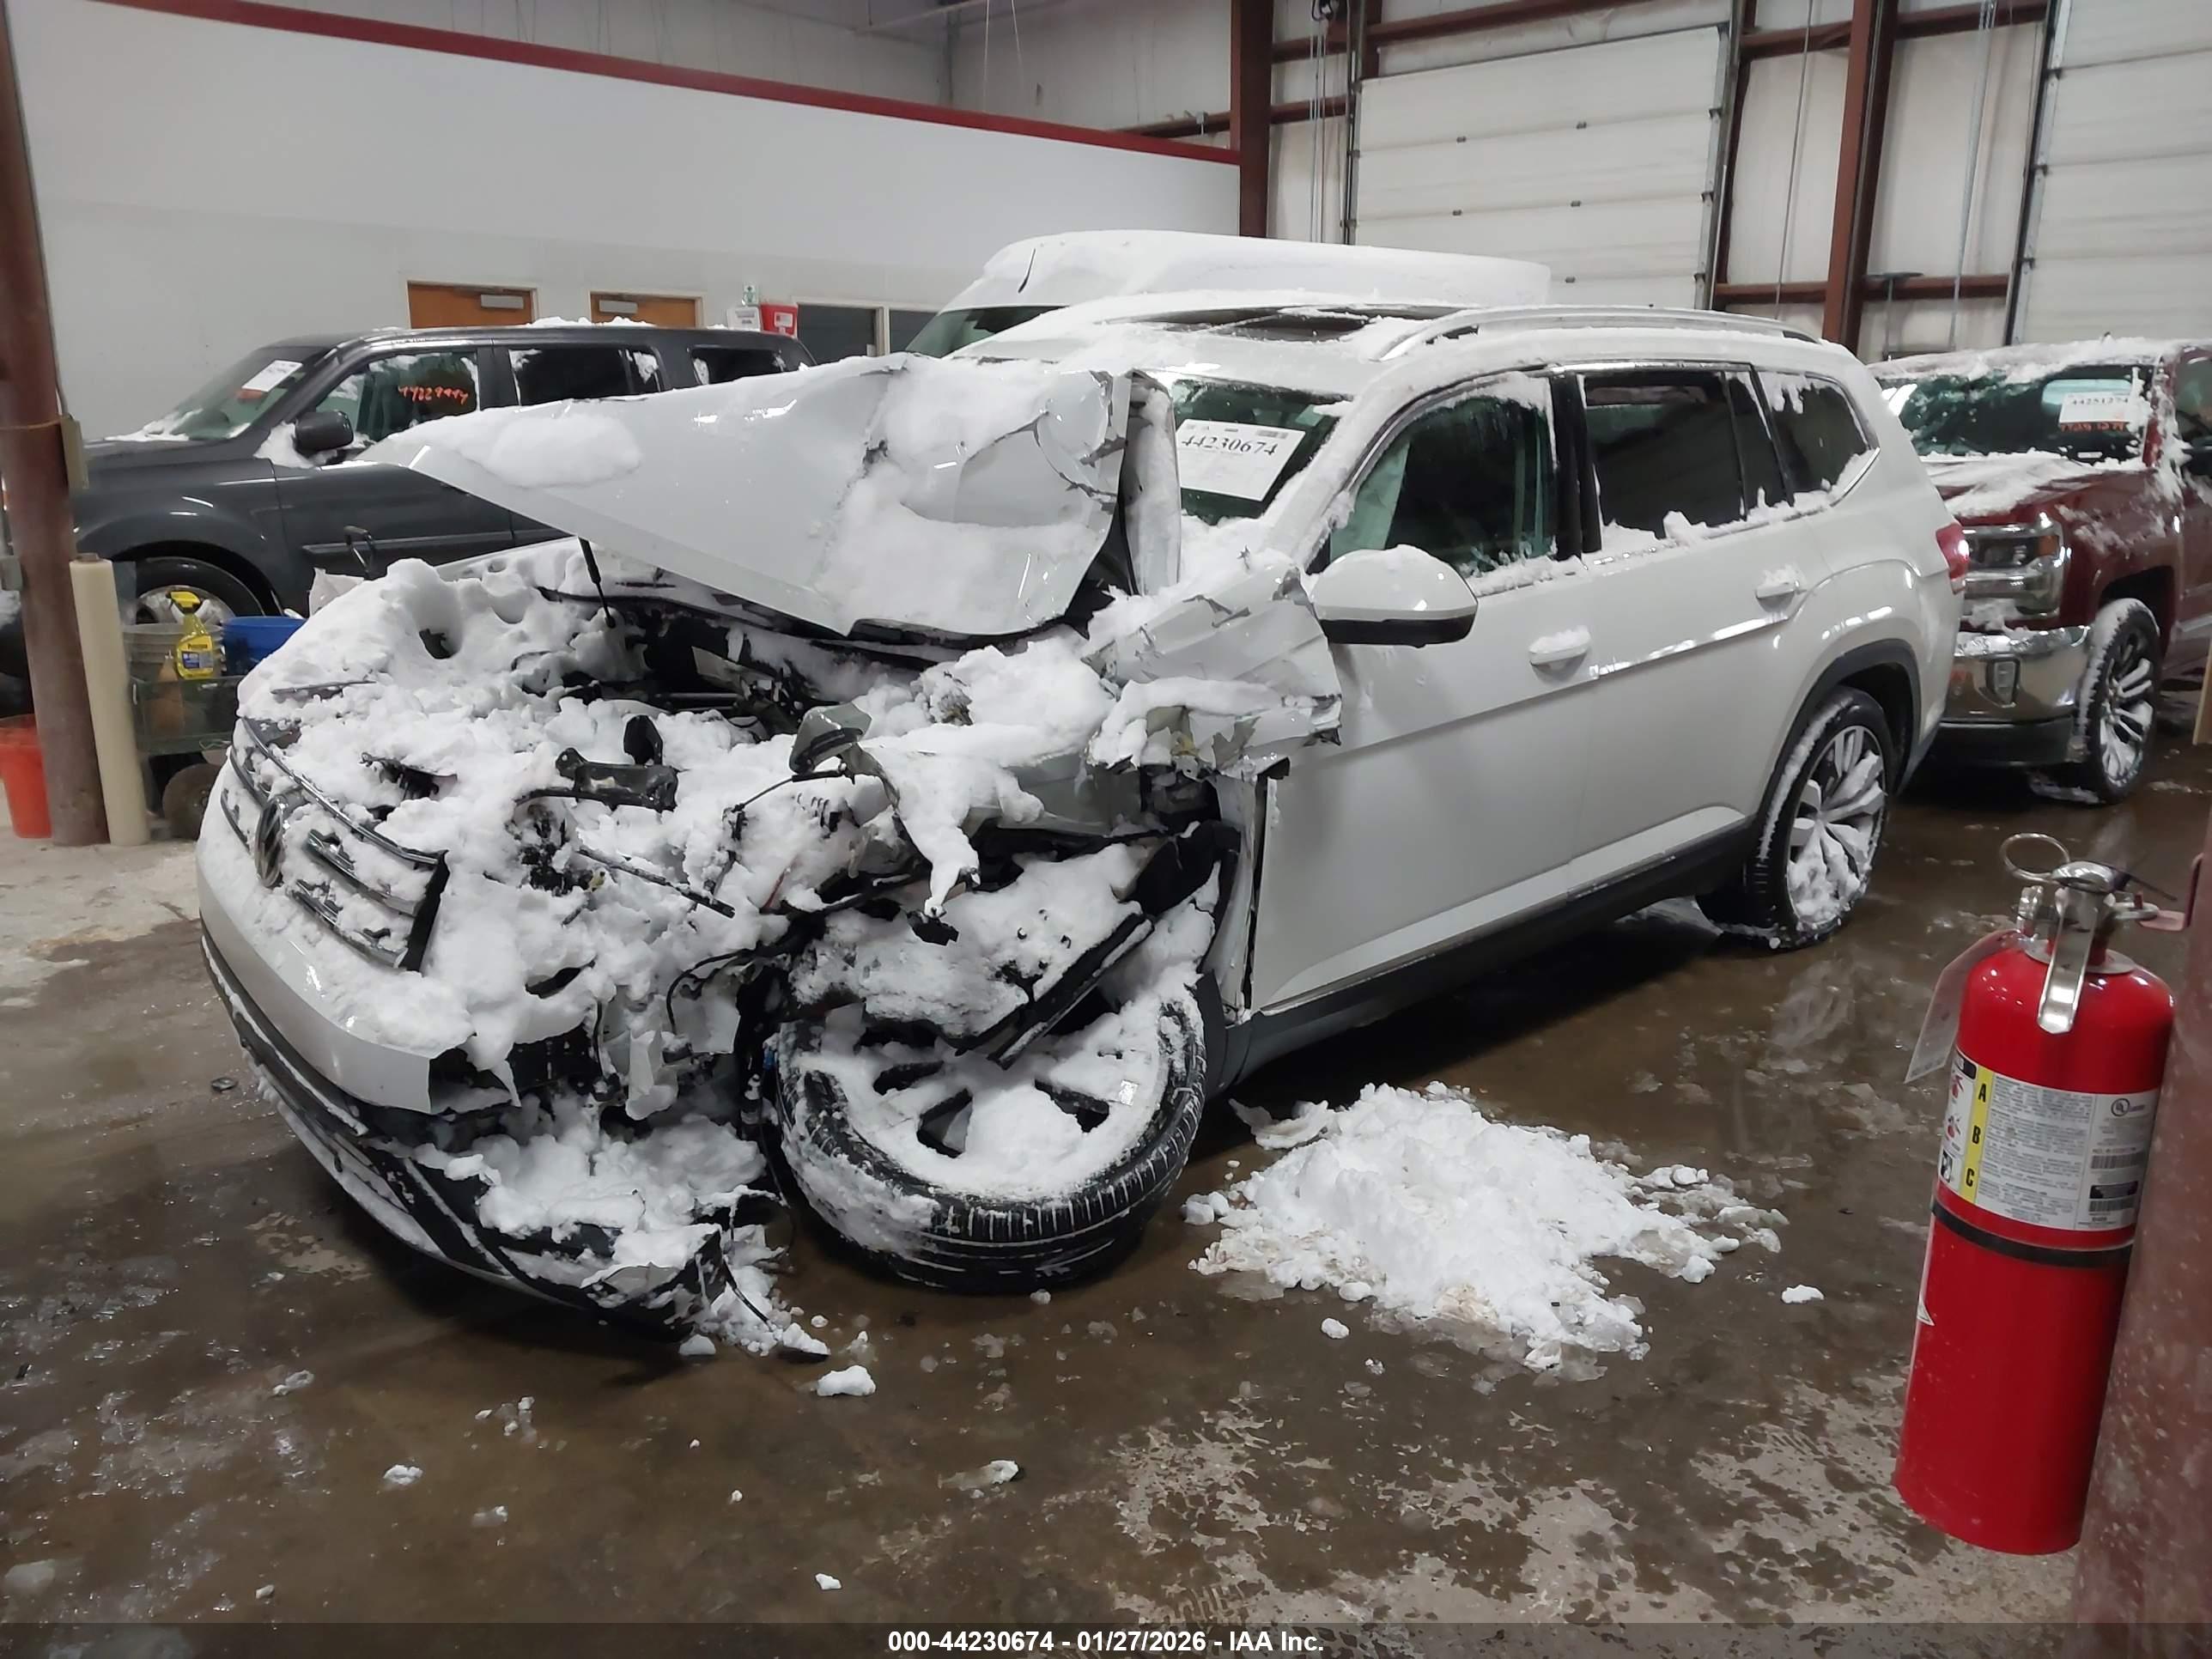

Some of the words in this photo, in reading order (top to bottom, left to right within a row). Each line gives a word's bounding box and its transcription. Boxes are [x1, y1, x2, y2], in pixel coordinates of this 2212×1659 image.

[1181, 434, 1279, 456] 44230674
[1978, 1083, 1987, 1103] A
[1972, 1125, 1982, 1145] B
[1966, 1168, 1975, 1188] C
